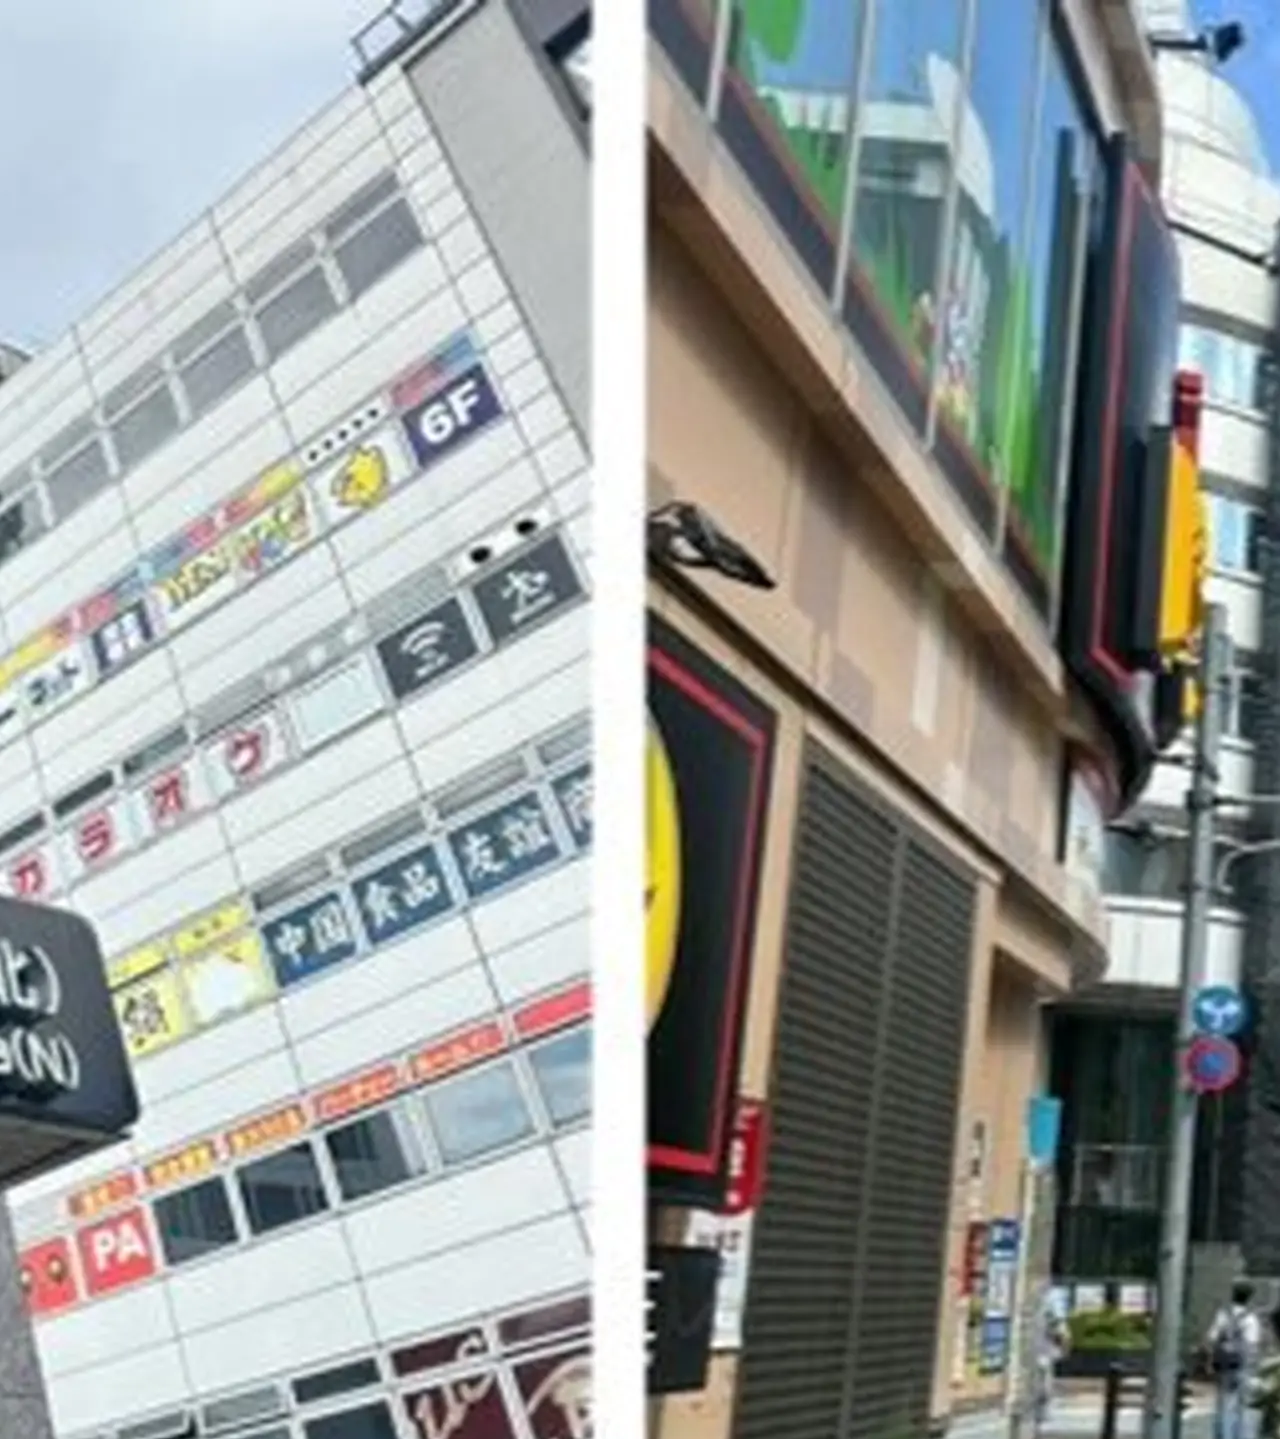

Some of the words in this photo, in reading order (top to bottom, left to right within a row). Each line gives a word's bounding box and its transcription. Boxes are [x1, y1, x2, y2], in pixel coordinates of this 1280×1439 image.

[420, 380, 484, 446] 6F
[10, 726, 272, 897] カラオケ
[92, 1224, 150, 1271] PA
